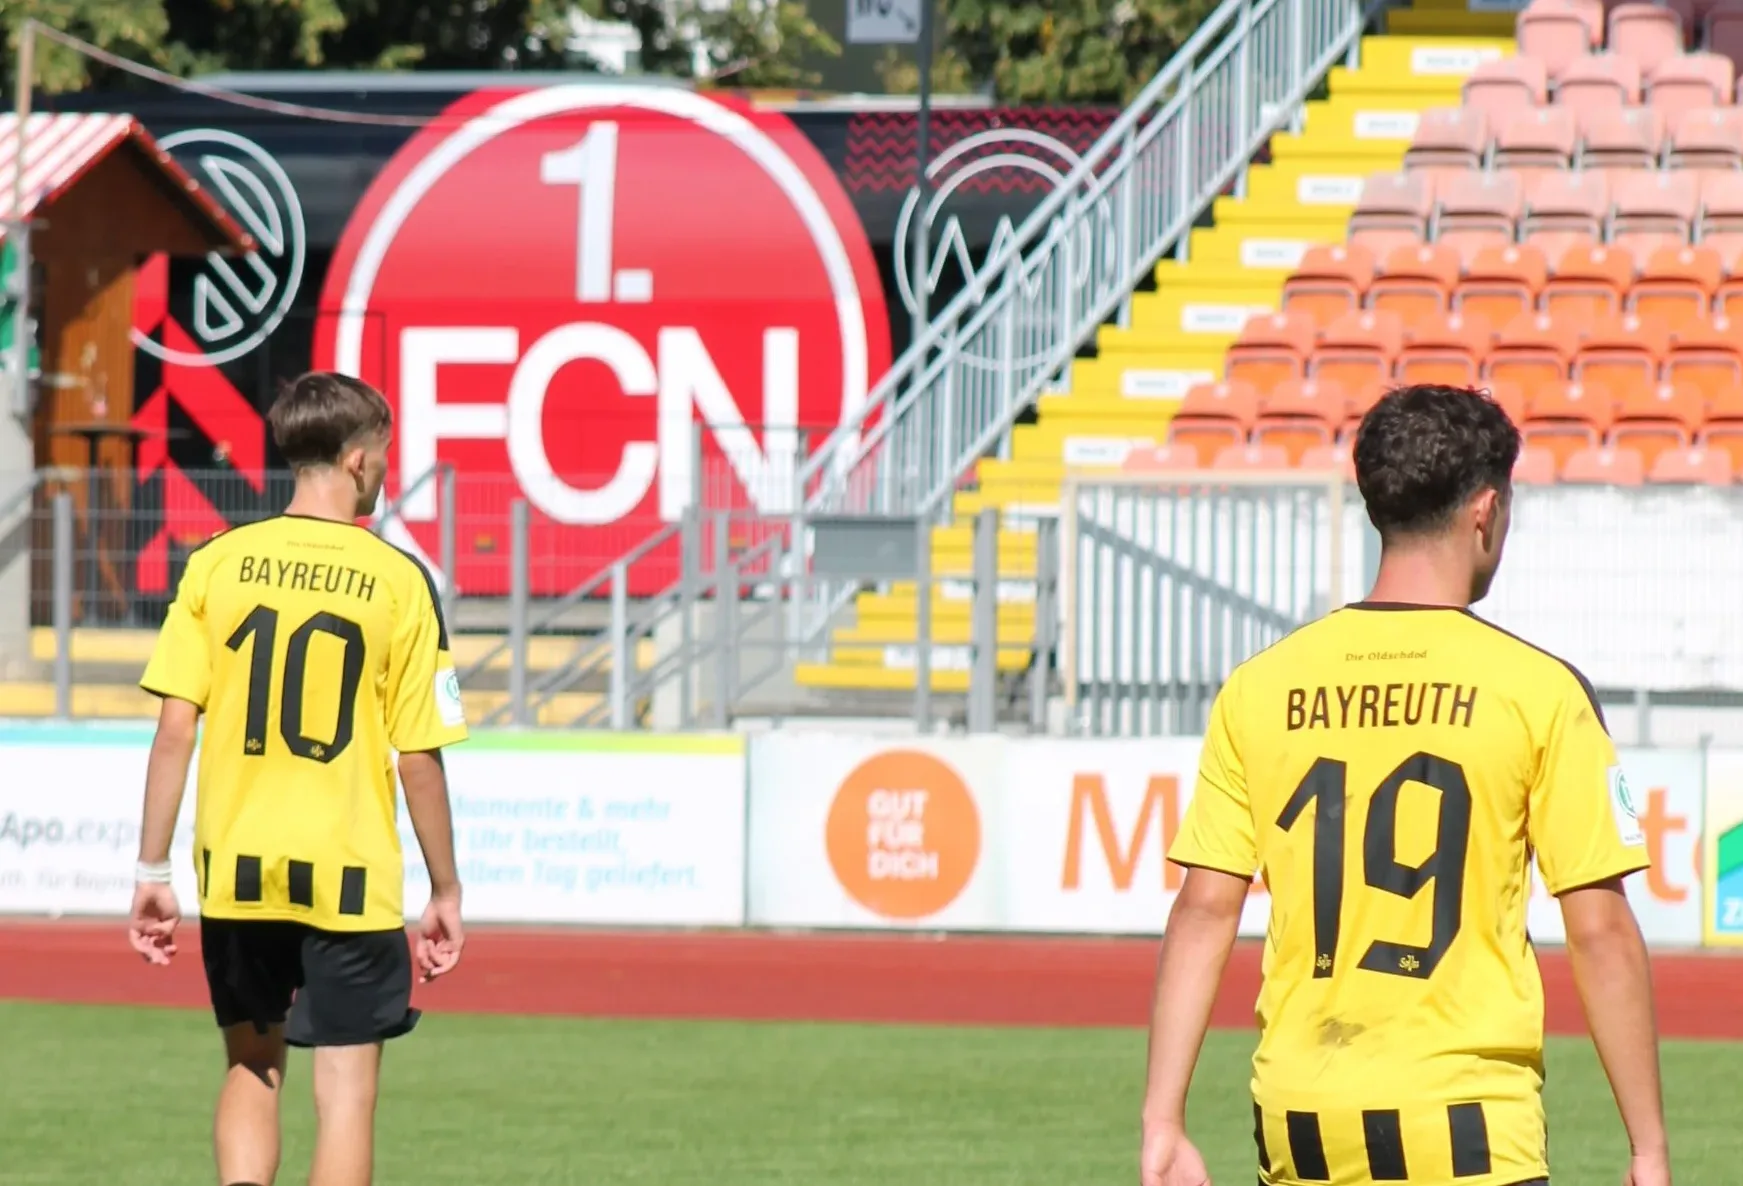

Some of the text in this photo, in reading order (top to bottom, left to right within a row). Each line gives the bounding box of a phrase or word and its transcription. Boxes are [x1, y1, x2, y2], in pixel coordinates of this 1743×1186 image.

[540, 120, 653, 303] 1.
[400, 320, 799, 525] FCN
[239, 555, 377, 602] BAYREUTH
[1344, 652, 1365, 662] Die
[225, 603, 366, 764] 10
[1286, 682, 1478, 731] BAYREUTH
[866, 789, 930, 819] GUT
[867, 820, 924, 847] FÜR
[867, 851, 940, 880] DICH
[1275, 751, 1473, 980] 19
